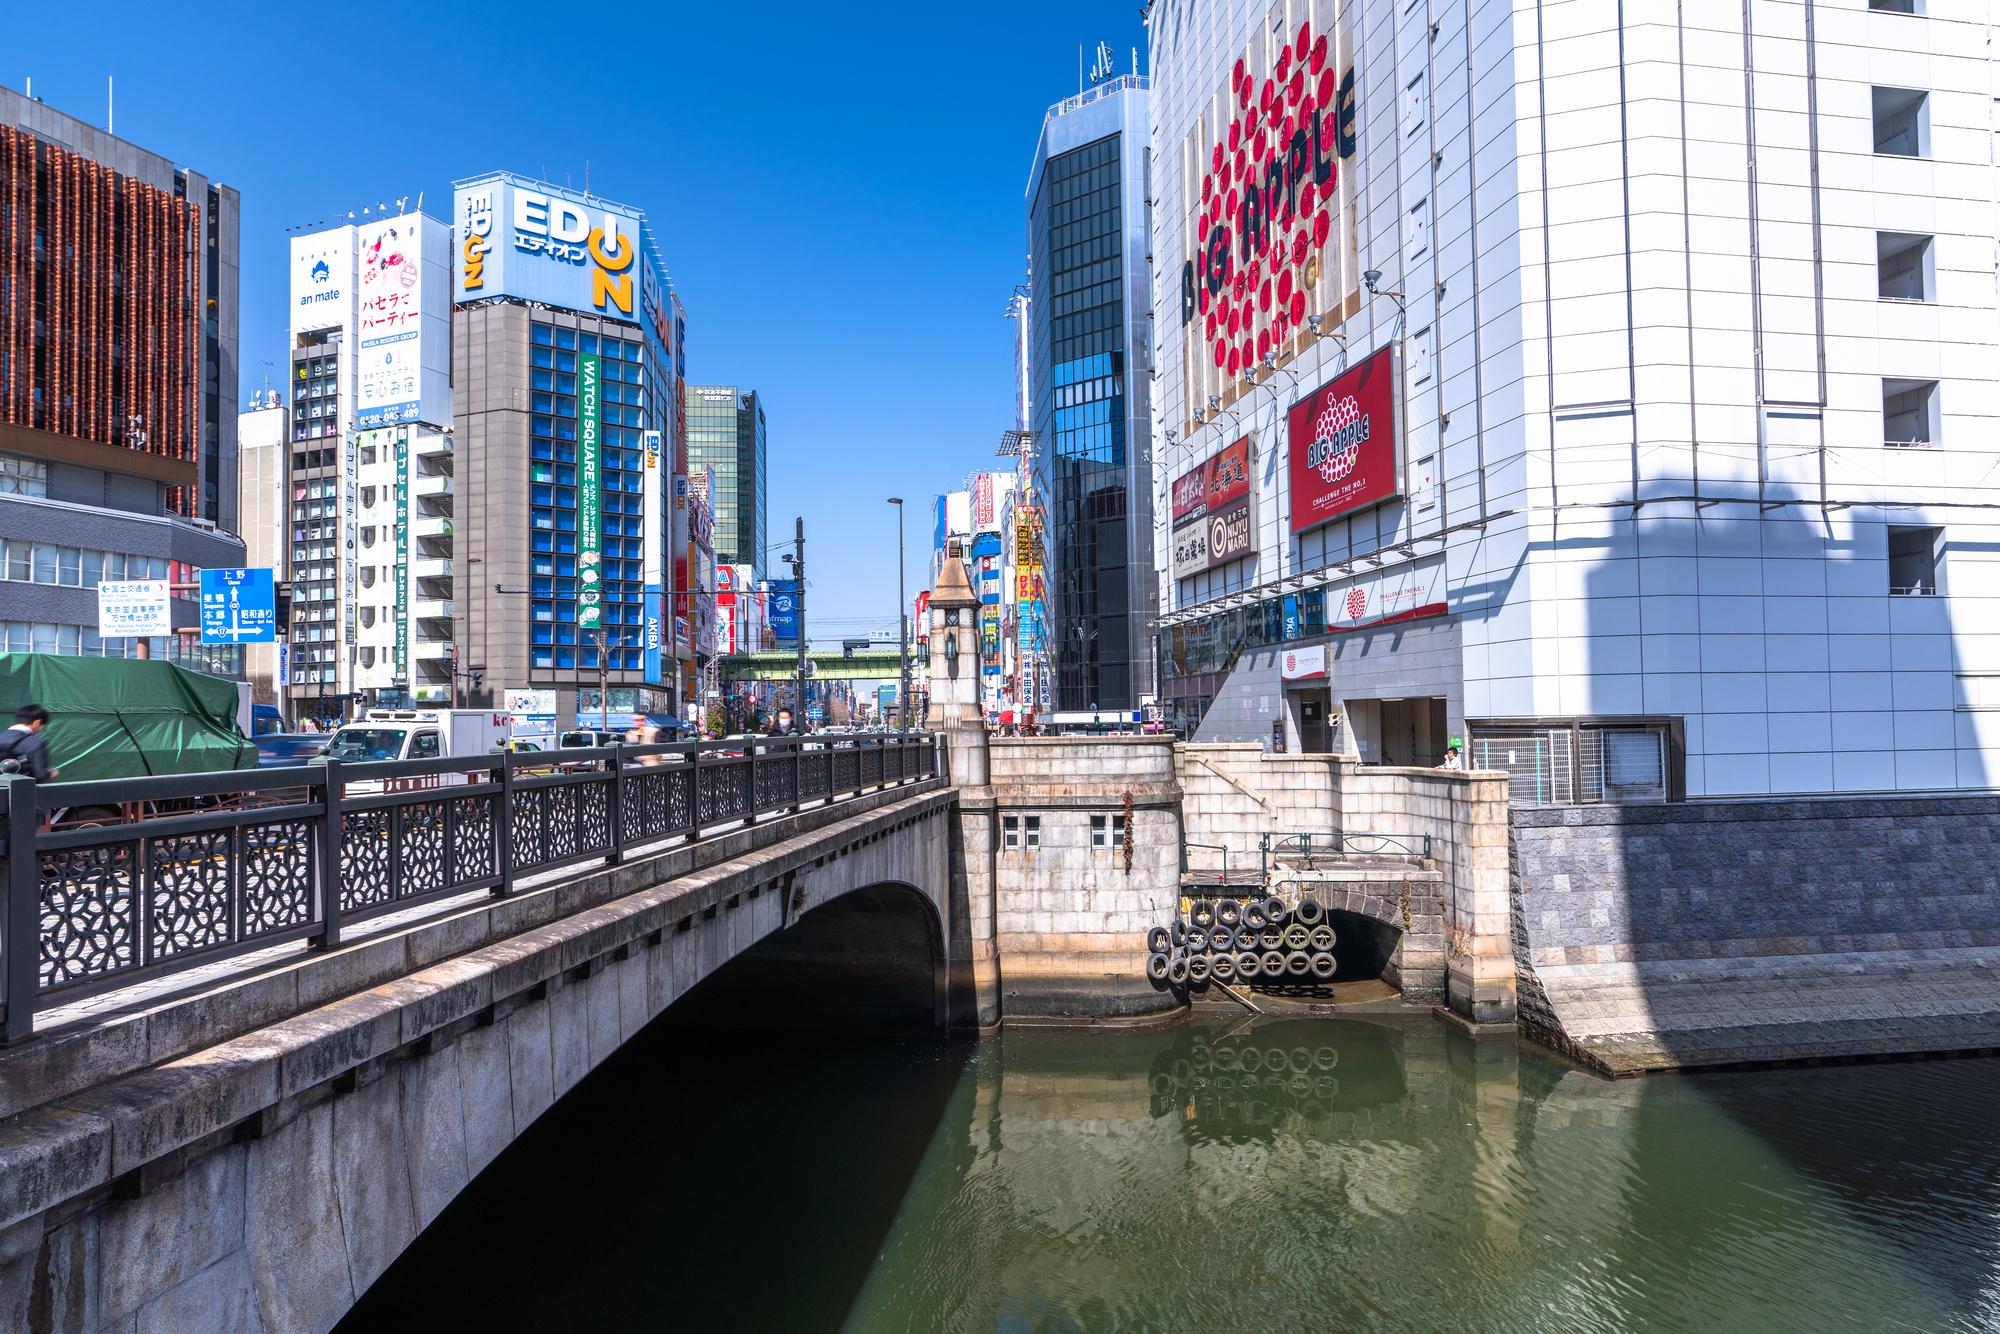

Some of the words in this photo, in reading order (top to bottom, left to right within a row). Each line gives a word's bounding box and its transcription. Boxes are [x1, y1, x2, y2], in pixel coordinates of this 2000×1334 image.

[1182, 224, 1228, 329] BIG
[1242, 65, 1356, 265] APPLE
[464, 191, 492, 289] EDION
[514, 232, 586, 261] エディオン
[514, 188, 633, 313] EDION
[362, 312, 418, 330] パーティー
[364, 376, 414, 399] 安心お宿
[584, 360, 594, 416] WATCH
[582, 418, 595, 482] SQUARE
[1308, 436, 1329, 470] BIG
[1332, 414, 1370, 457] APPLE
[1210, 461, 1245, 495] 北海道
[1313, 489, 1340, 506] CHALLENGE
[1342, 484, 1351, 493] THE
[986, 512, 991, 521] TO
[1228, 518, 1247, 539] NIJYU
[1228, 532, 1248, 553] MARU
[223, 570, 246, 579] 上野
[112, 585, 150, 593] 国土交通省
[1019, 575, 1029, 598] DVD
[106, 605, 164, 614] 東京国道事務所
[112, 614, 158, 622] 万世橋出張所
[204, 610, 225, 619] 本郷
[241, 609, 272, 619] 昭和通り
[648, 617, 658, 650] AKIBA
